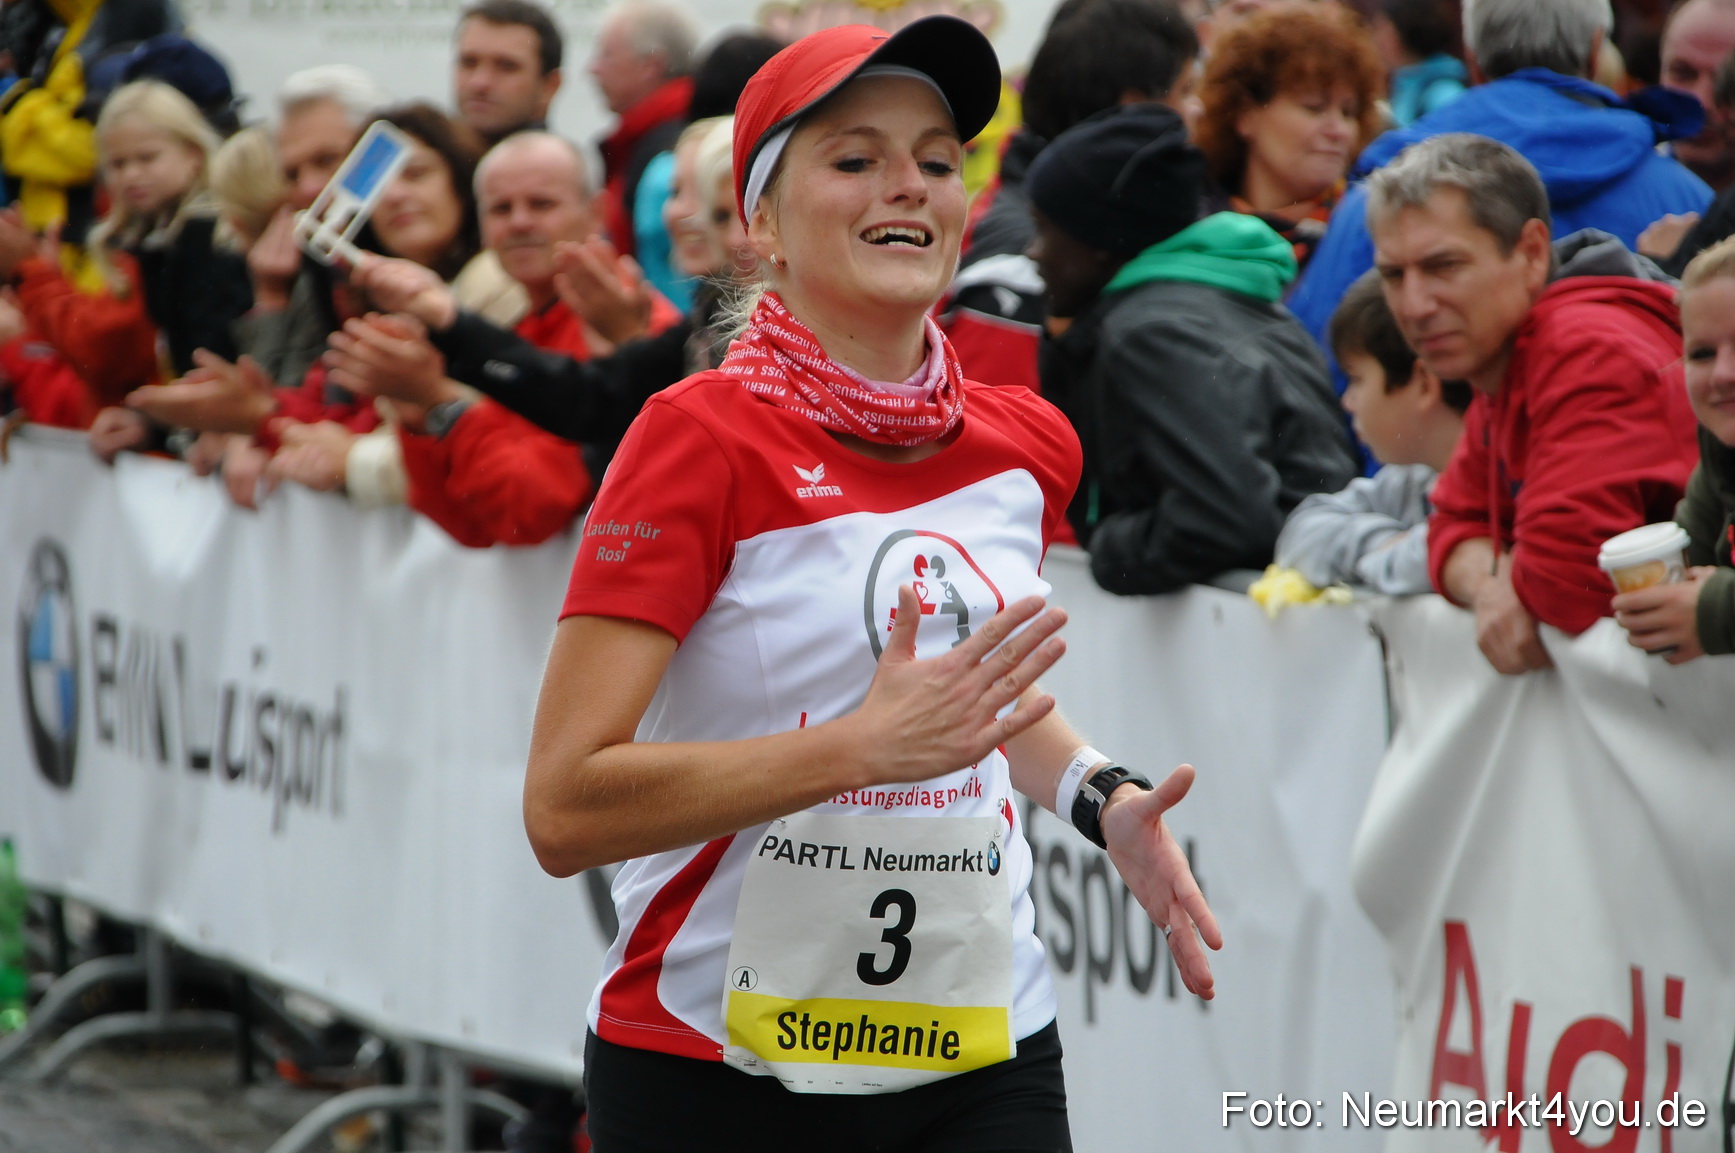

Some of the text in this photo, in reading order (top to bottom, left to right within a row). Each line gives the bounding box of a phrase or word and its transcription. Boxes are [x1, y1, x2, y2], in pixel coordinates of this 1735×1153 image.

[796, 483, 843, 498] erima
[587, 519, 661, 540] Laufen für
[596, 543, 628, 562] Rosi
[758, 834, 983, 873] PARTL Neumarkt
[856, 888, 917, 986] 3
[777, 1011, 960, 1061] Stephanie
